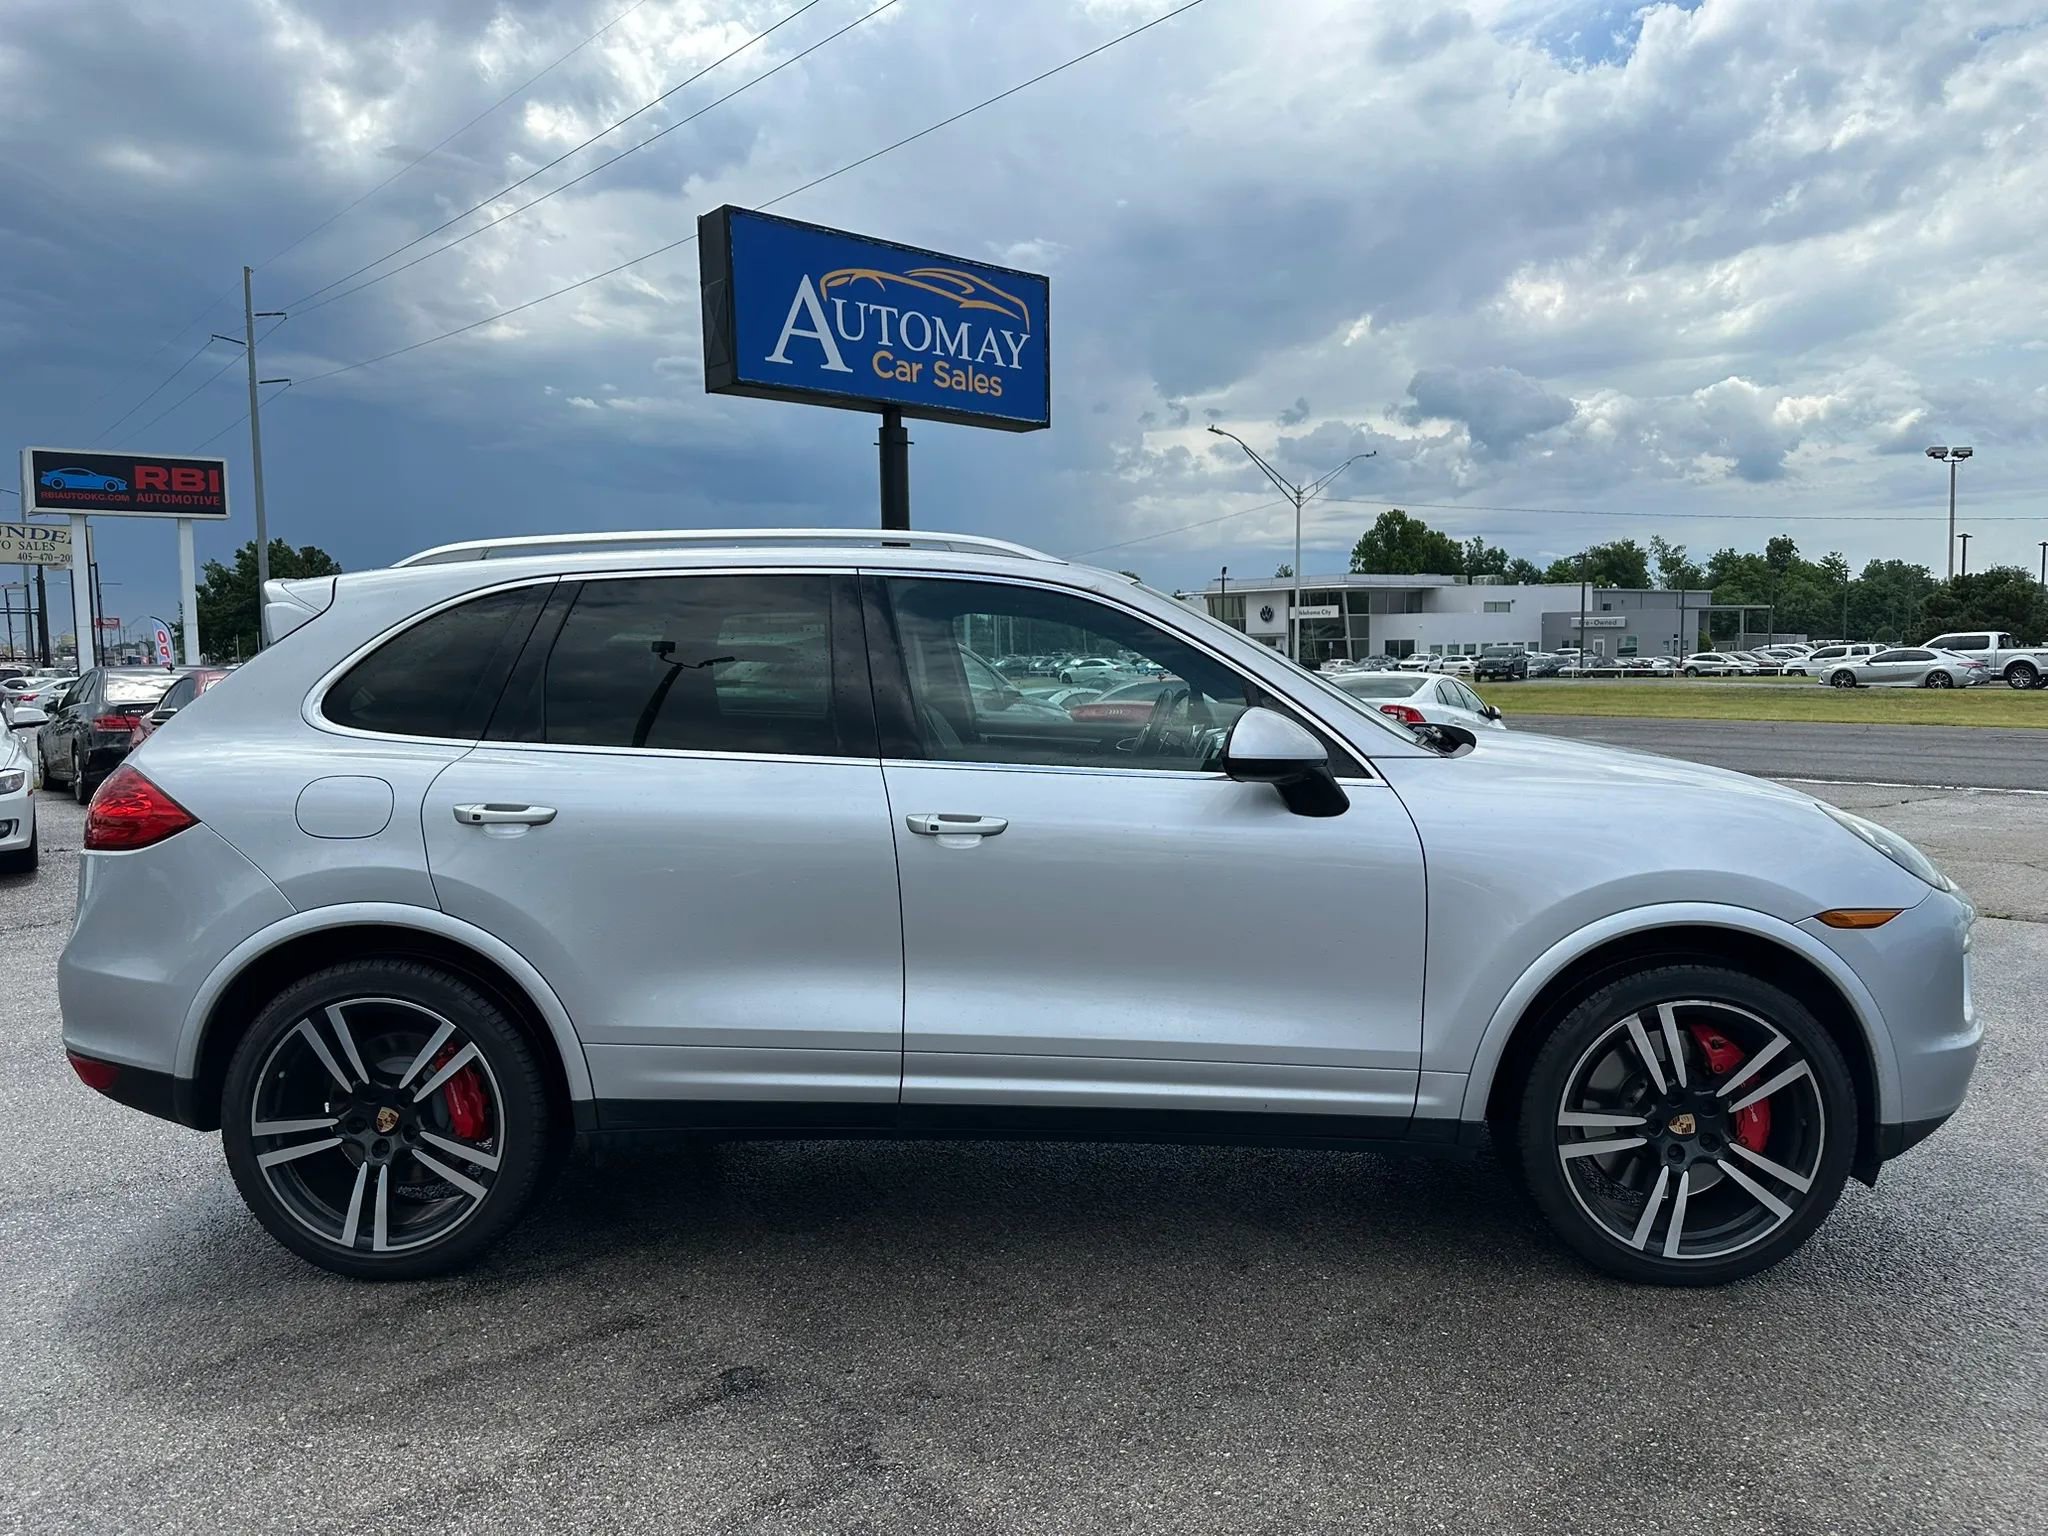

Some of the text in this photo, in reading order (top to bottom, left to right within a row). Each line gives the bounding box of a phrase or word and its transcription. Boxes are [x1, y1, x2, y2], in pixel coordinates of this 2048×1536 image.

[764, 273, 1031, 373] AUTOMAY
[872, 351, 1003, 397] Car Sales
[133, 464, 221, 493] RBI
[136, 493, 221, 506] AUTOMOTIVE
[0, 525, 72, 545] NDE
[18, 541, 56, 552] SALES
[1321, 608, 1332, 616] City
